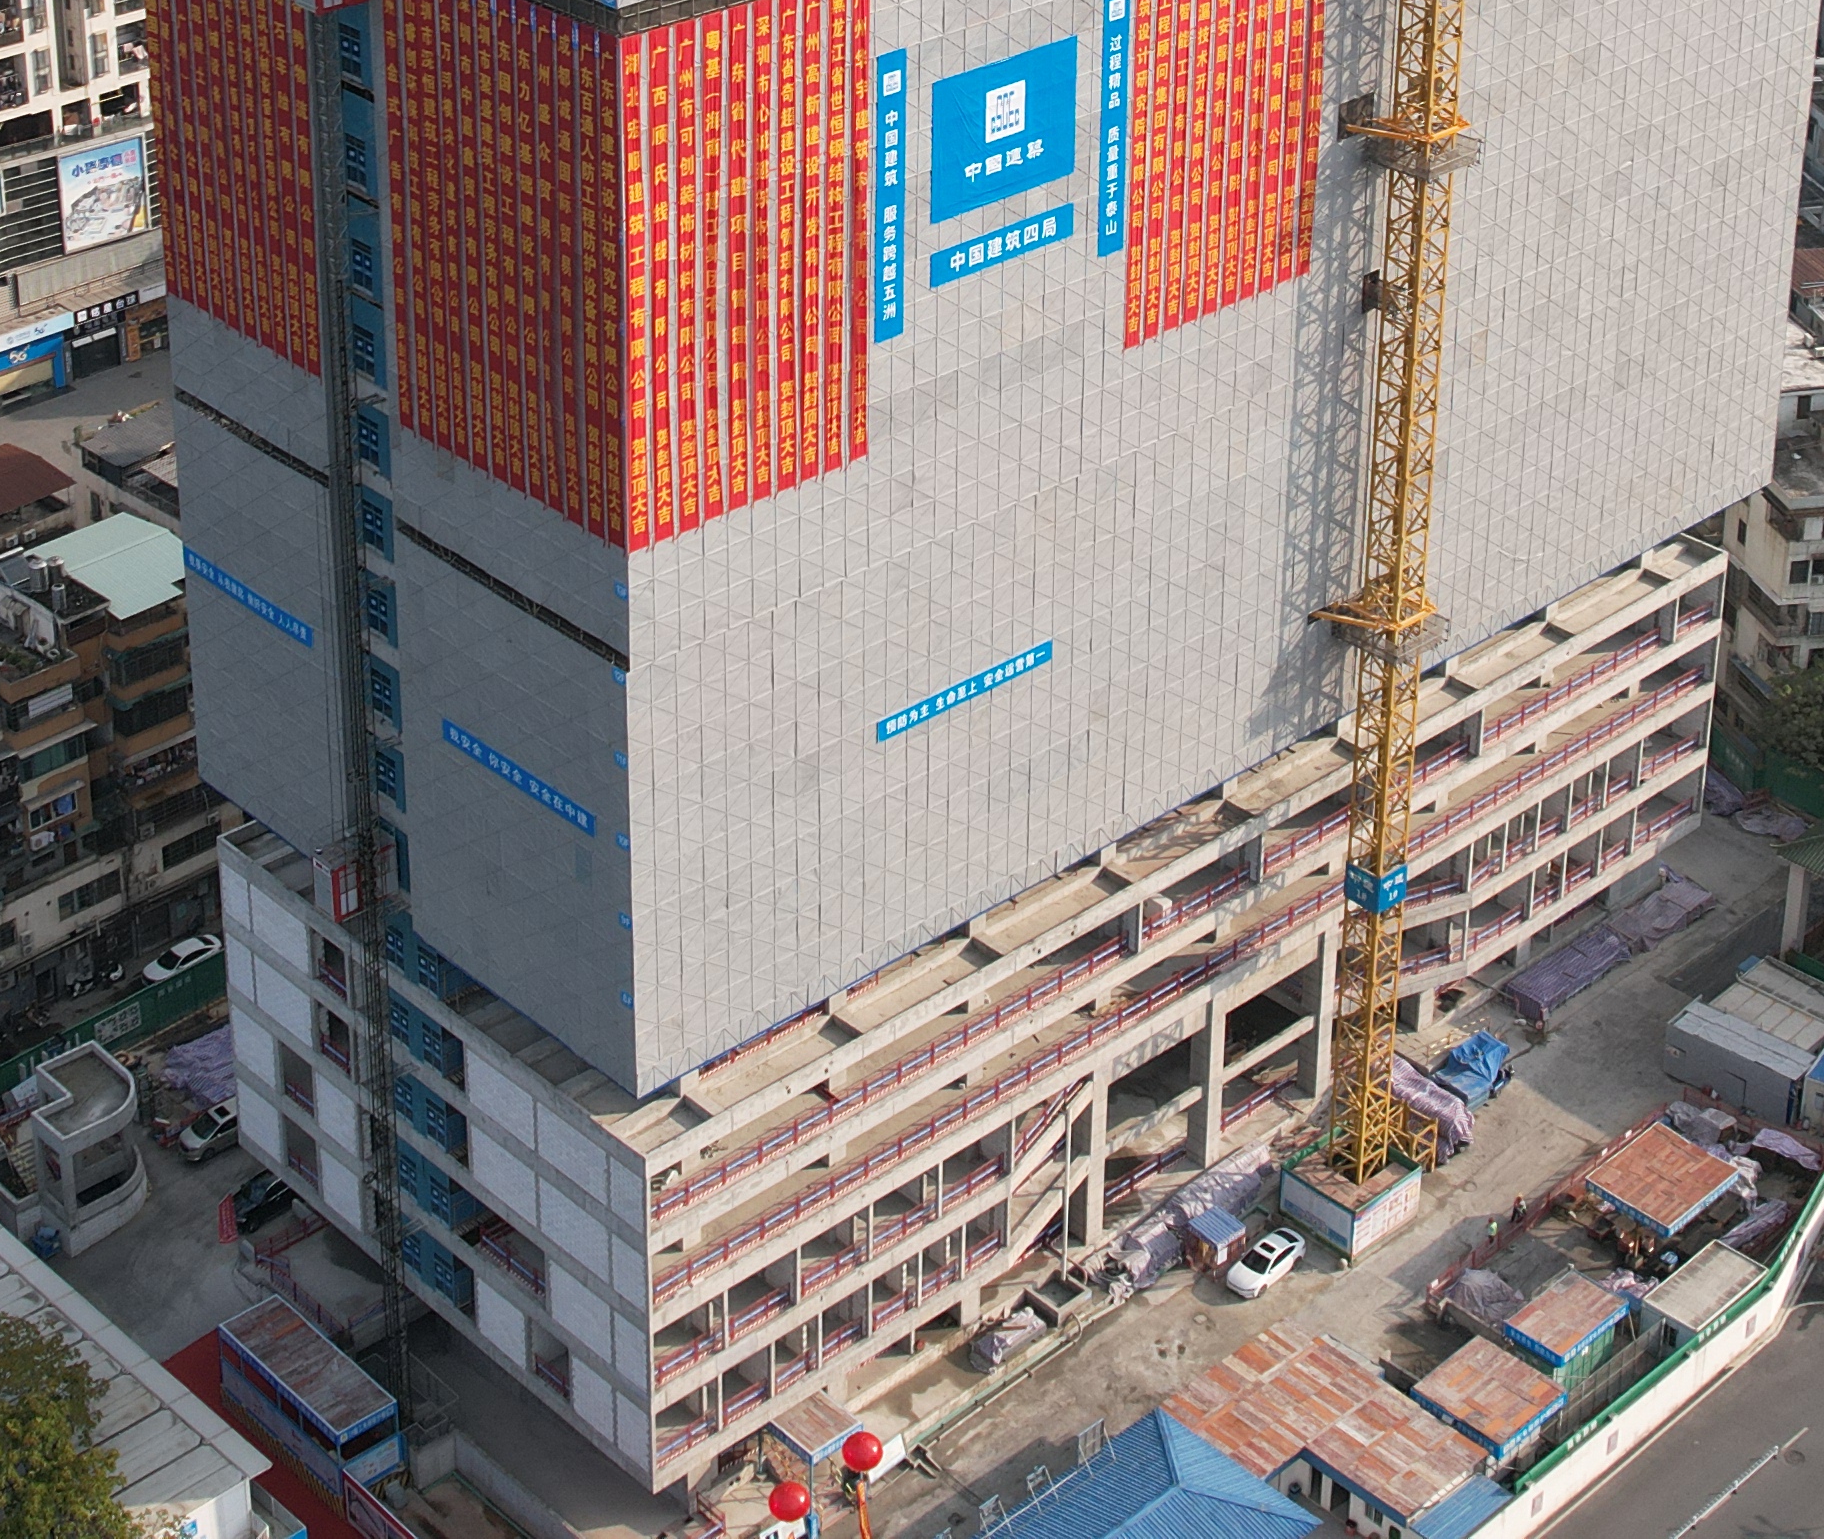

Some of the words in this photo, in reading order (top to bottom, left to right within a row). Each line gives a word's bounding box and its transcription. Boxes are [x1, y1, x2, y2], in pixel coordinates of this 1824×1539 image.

[1107, 33, 1124, 109] 过程精品
[883, 109, 899, 187] 中国建筑
[1104, 125, 1121, 236] 质量重于泰山
[882, 204, 898, 321] 服务跨越五洲
[949, 215, 1058, 272] 中国建筑四局
[732, 399, 747, 494] 贺封顶大吉
[780, 380, 796, 476] 贺封顶大吉
[804, 371, 819, 465] 贺封顶大吉
[632, 439, 647, 535] 贺封顶大吉
[681, 419, 697, 517] 贺封顶大吉
[935, 680, 978, 712] 生命至上
